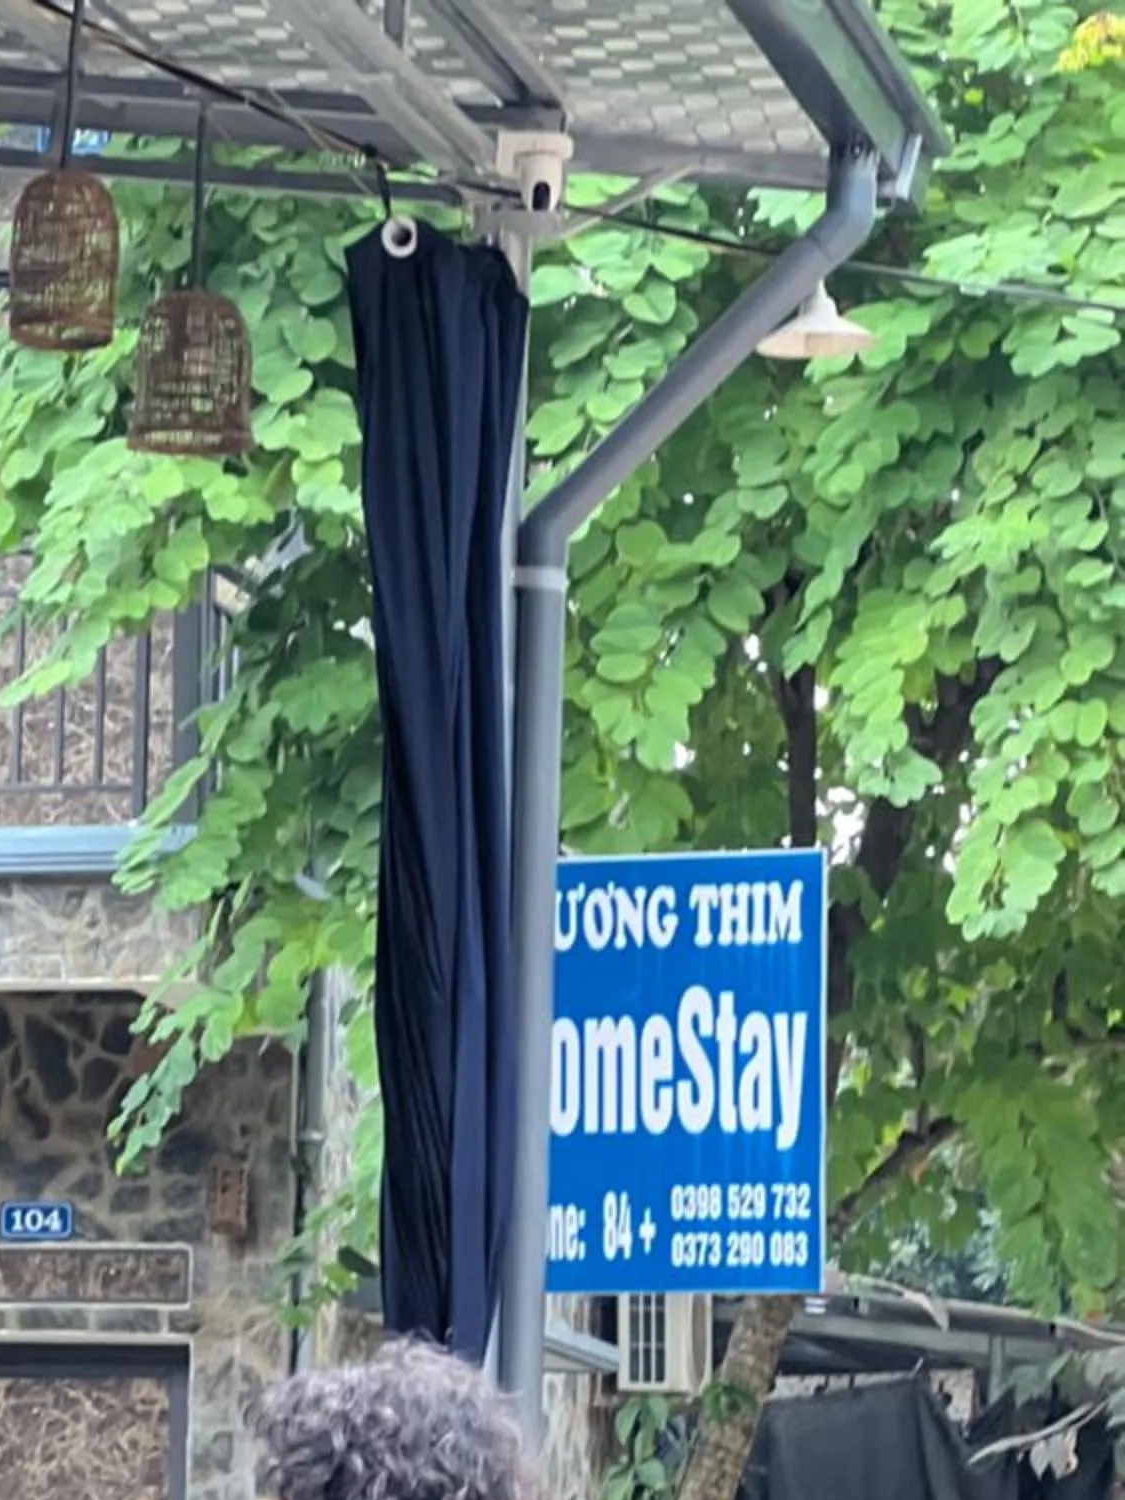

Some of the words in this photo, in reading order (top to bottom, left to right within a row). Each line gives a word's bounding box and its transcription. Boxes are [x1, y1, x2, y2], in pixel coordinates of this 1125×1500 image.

[689, 879, 804, 948] THIM
[549, 984, 808, 1152] omeStay
[11, 1208, 62, 1232] 104
[546, 1203, 586, 1262] ne:
[603, 1190, 633, 1261] 84
[671, 1183, 722, 1220] 0398
[771, 1182, 811, 1219] 732
[671, 1232, 722, 1268] 0373
[727, 1231, 765, 1267] 290
[769, 1230, 808, 1267] 083
